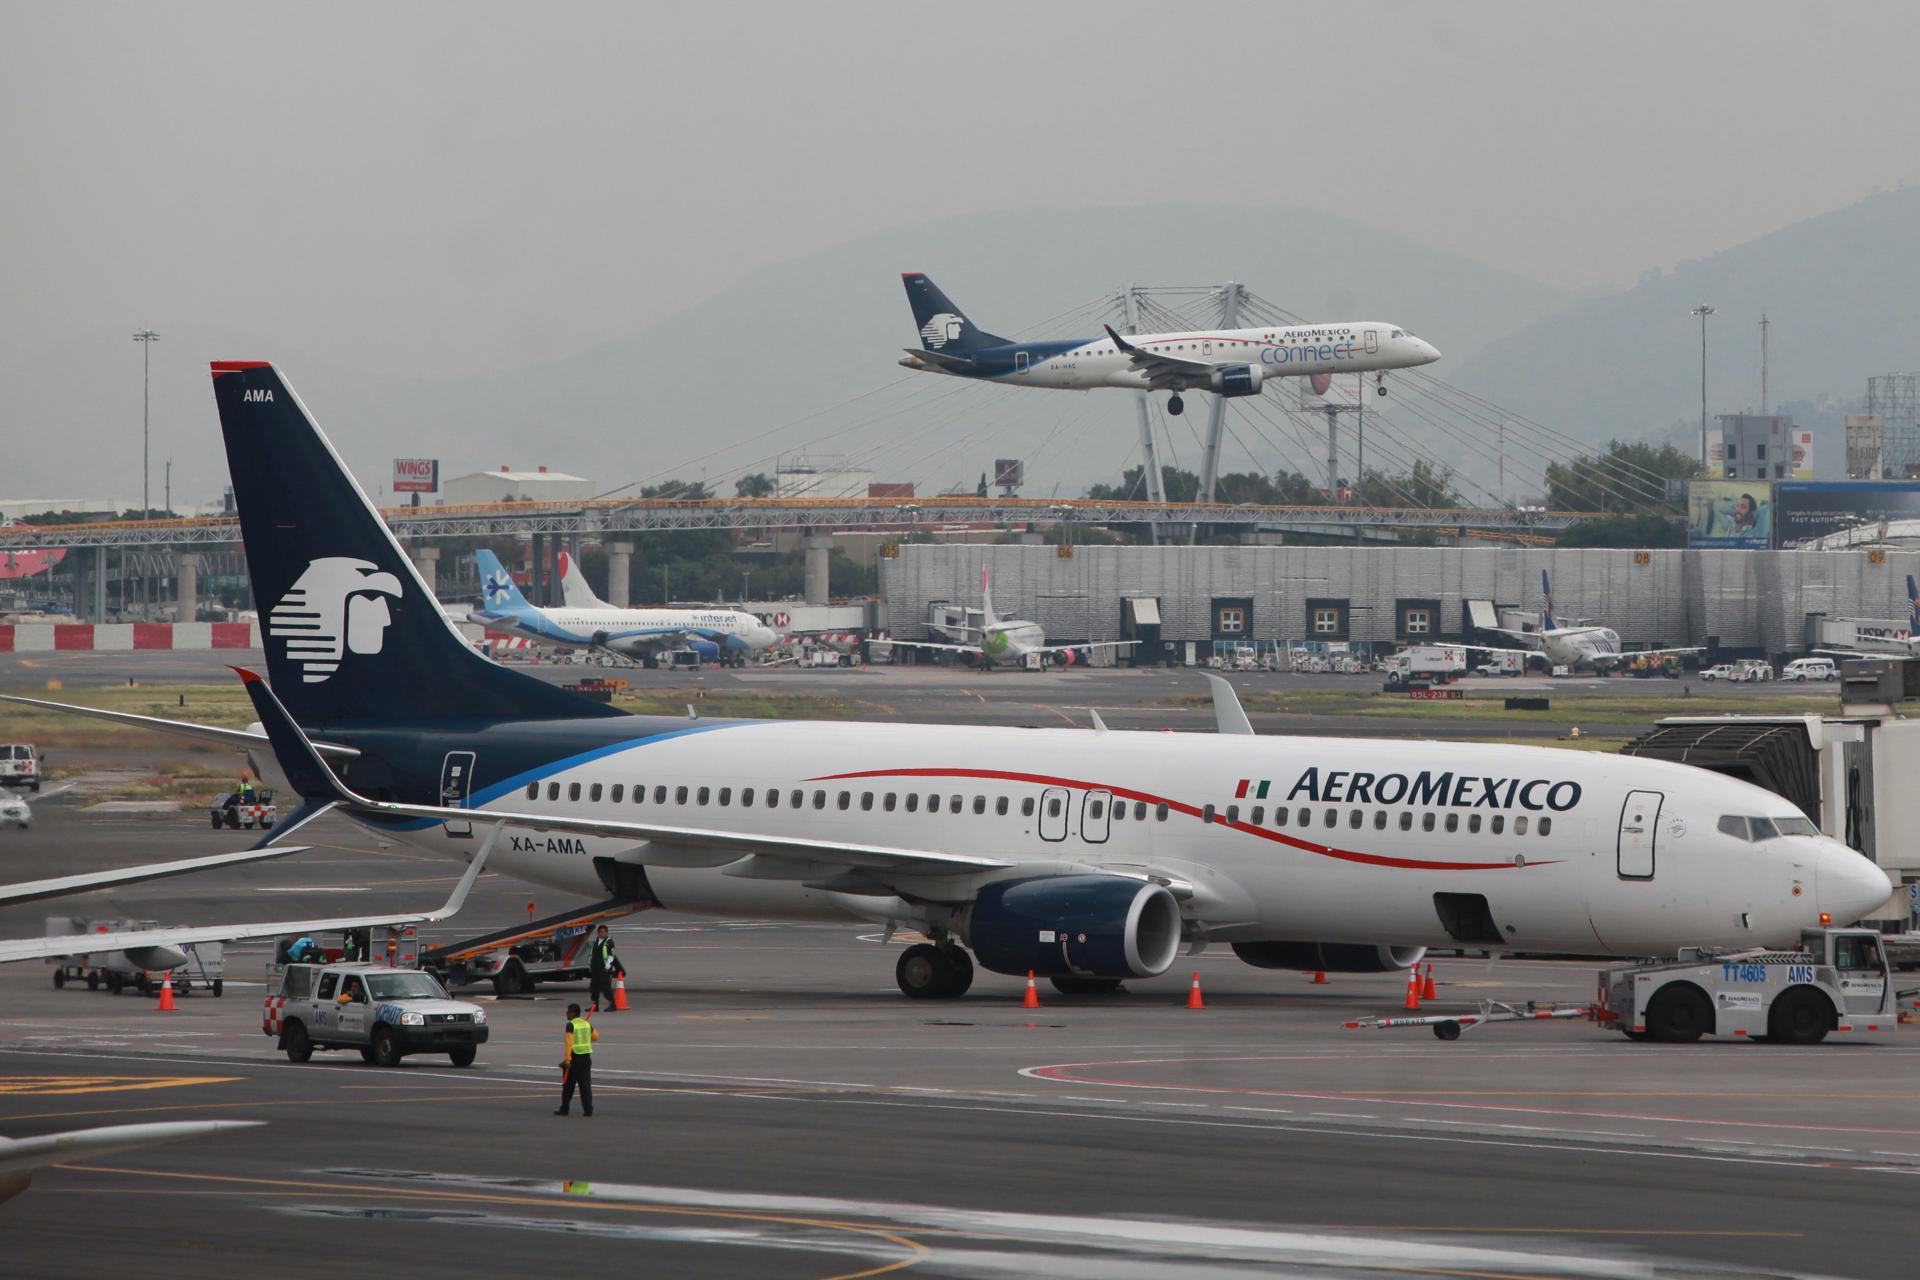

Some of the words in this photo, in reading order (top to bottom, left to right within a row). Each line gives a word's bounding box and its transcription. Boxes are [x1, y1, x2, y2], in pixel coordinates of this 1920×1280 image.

[1283, 328, 1350, 338] AEROMEXICO
[1261, 340, 1355, 364] connect
[243, 389, 274, 402] AMA
[396, 461, 431, 475] WINGS
[1857, 627, 1892, 643] HSBC
[1287, 766, 1582, 812] AEROMEXICO
[510, 836, 586, 855] XA-AMA
[1722, 961, 1766, 983] TT4605
[1788, 966, 1814, 983] AMS
